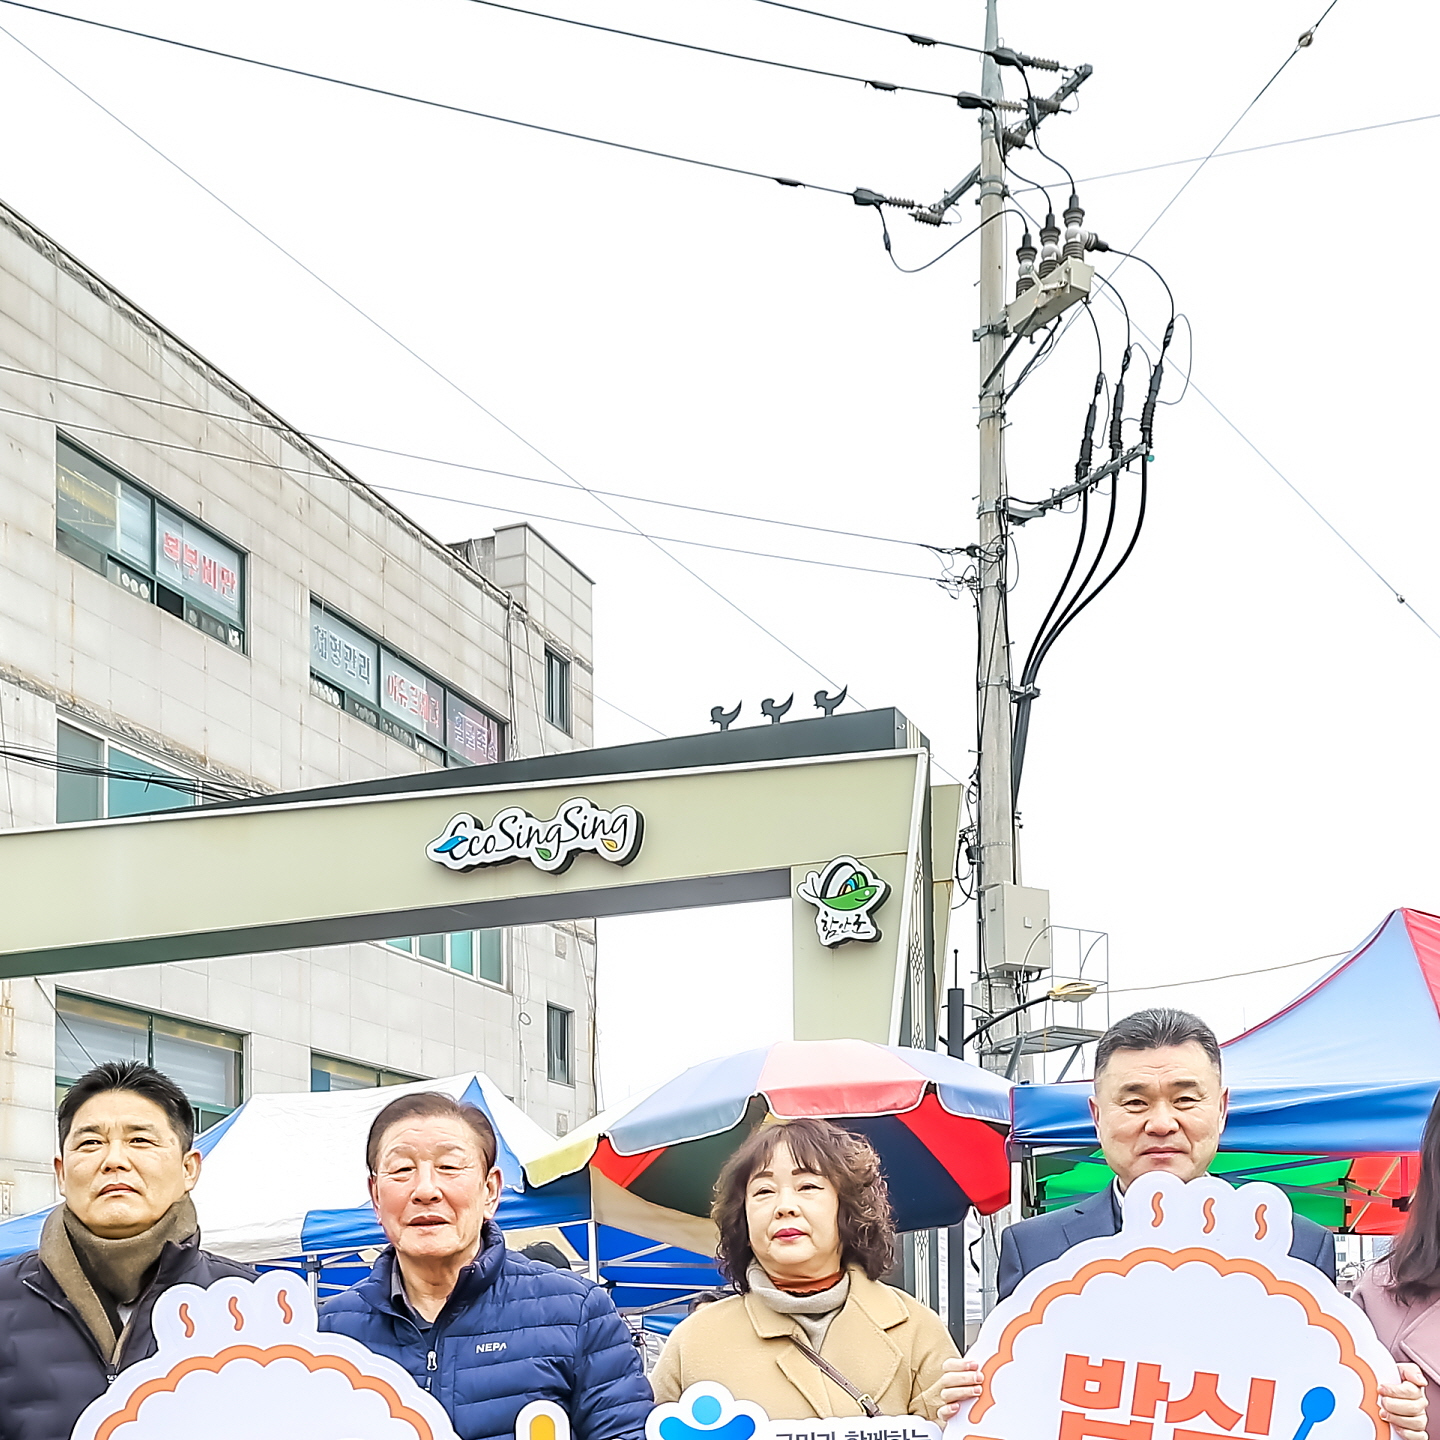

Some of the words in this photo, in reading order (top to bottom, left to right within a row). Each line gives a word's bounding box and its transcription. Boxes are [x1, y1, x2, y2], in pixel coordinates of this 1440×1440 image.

[448, 805, 629, 862] EcoSingSing
[820, 911, 871, 940] 함안군
[475, 1341, 508, 1354] NEPA
